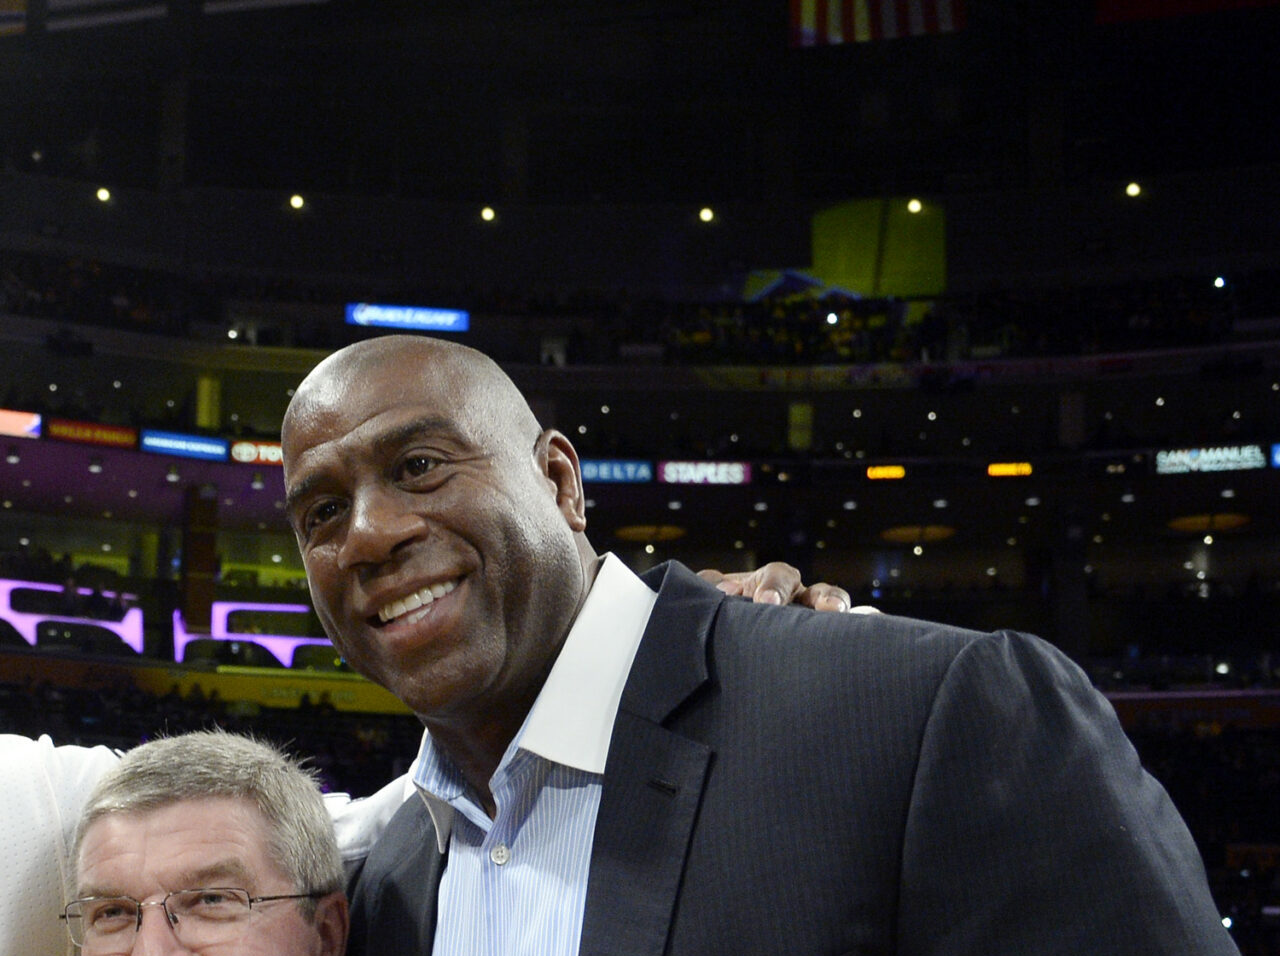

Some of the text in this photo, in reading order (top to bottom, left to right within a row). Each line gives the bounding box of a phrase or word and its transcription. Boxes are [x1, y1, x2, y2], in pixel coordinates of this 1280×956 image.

[257, 445, 284, 462] TO
[1199, 445, 1262, 463] MANUEL
[582, 462, 652, 480] DELTA
[663, 462, 746, 483] STAPLES
